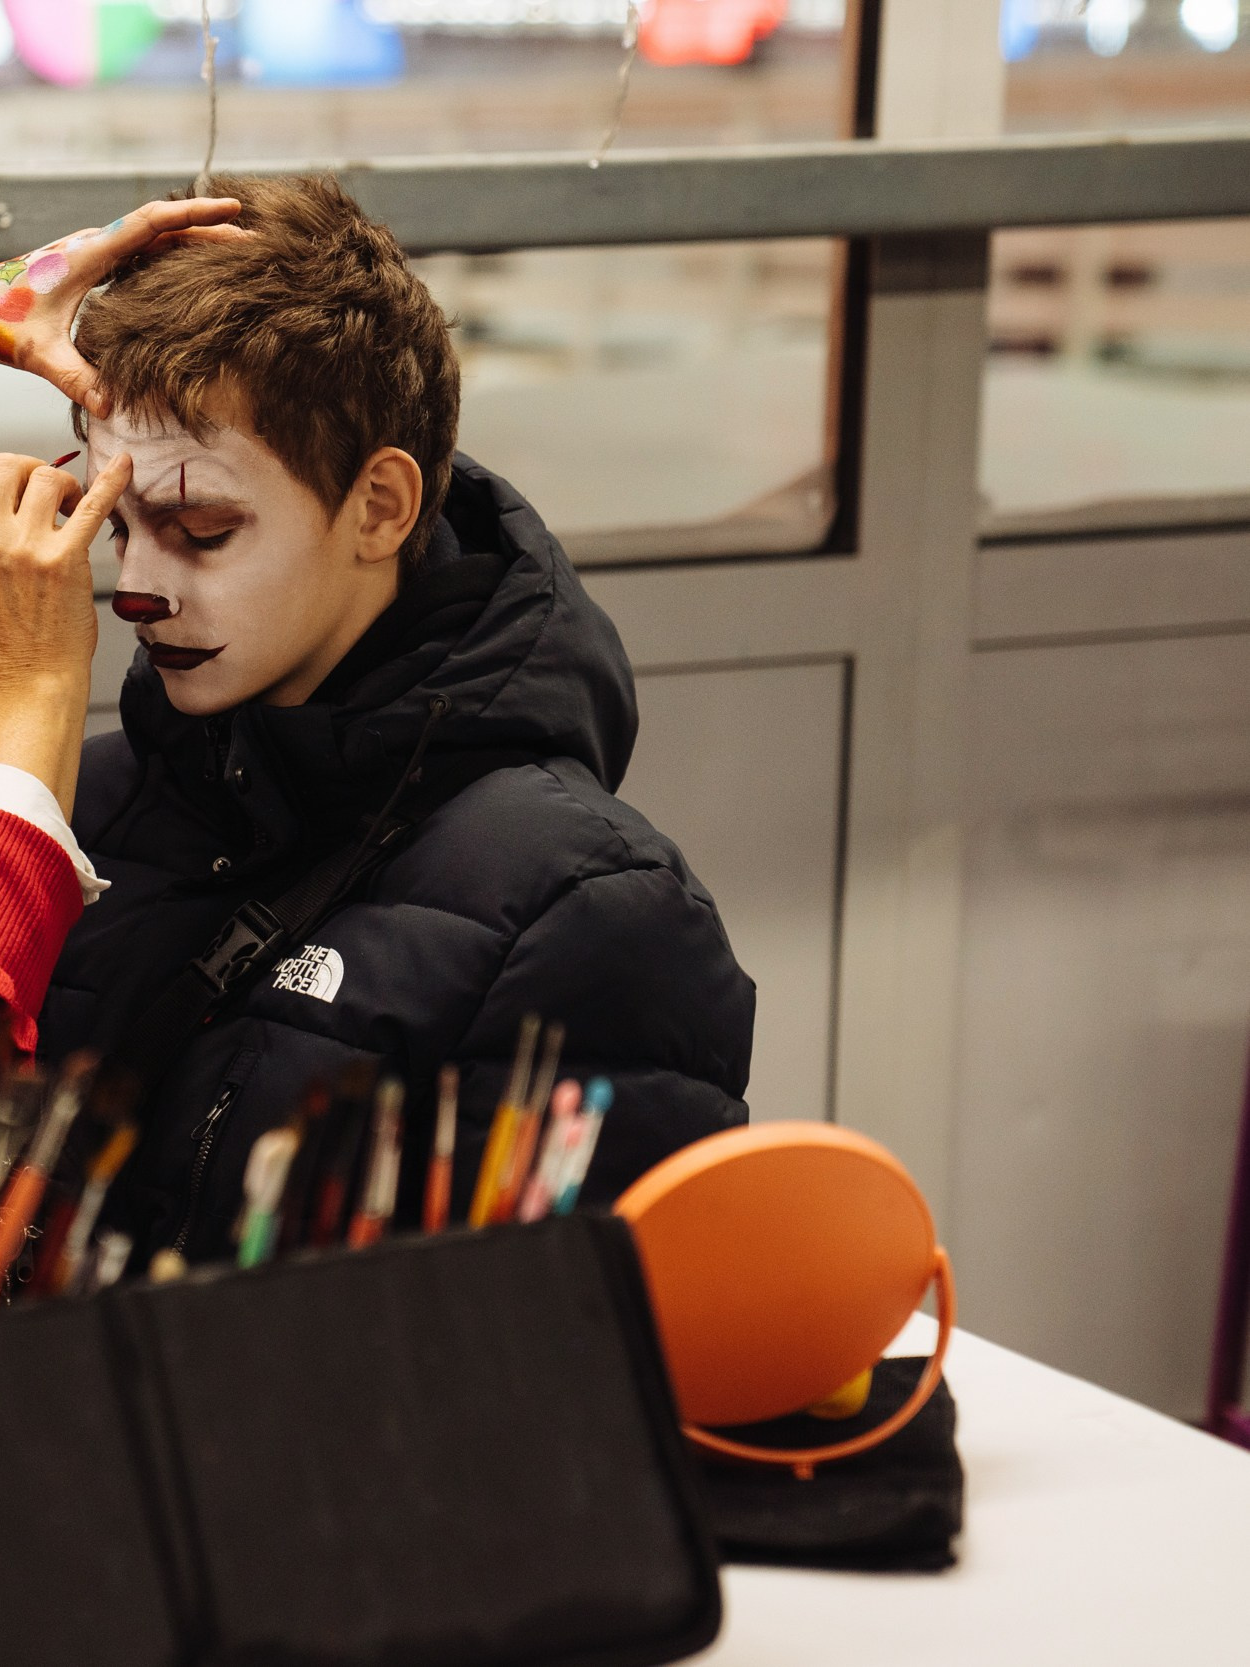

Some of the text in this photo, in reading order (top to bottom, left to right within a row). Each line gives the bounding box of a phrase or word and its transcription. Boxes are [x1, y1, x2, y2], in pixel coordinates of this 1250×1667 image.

[300, 944, 329, 963] THE
[271, 957, 321, 980] NORTH
[272, 973, 312, 994] FACE
